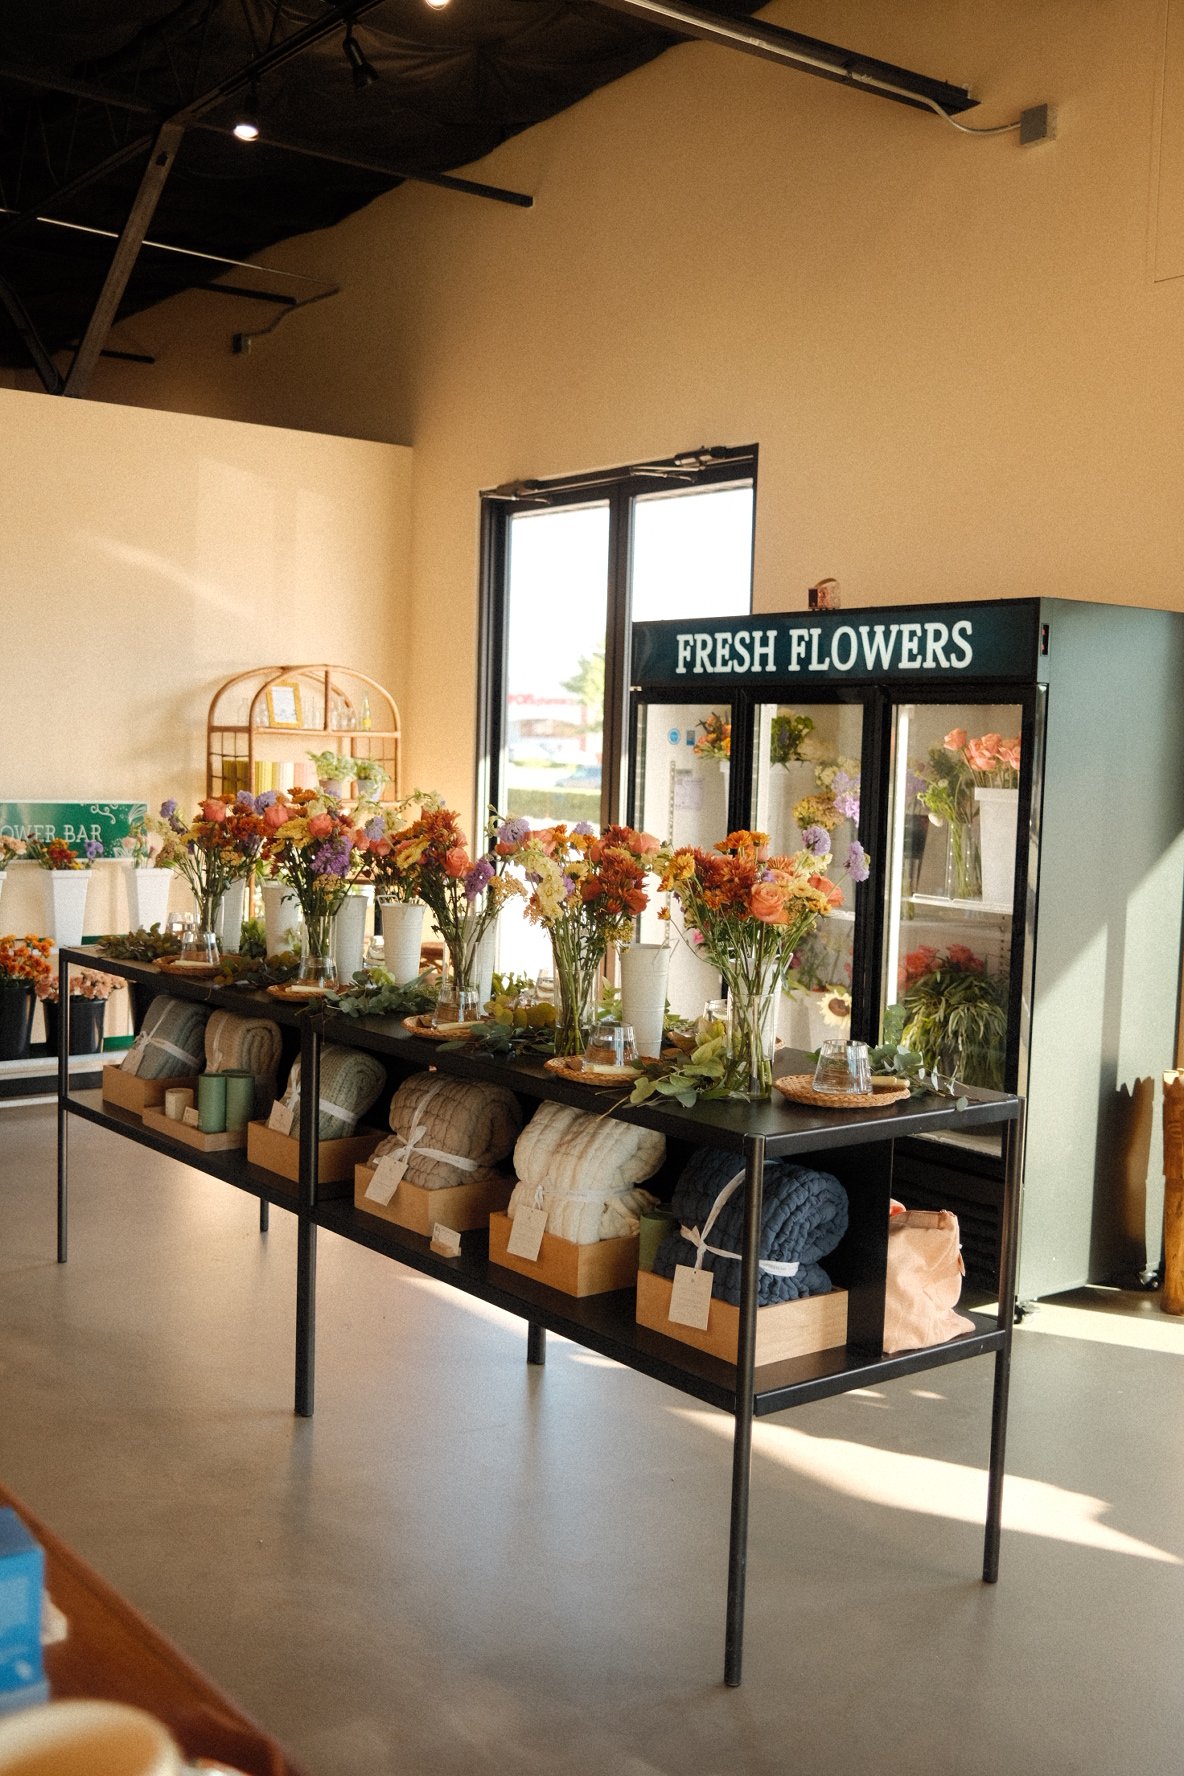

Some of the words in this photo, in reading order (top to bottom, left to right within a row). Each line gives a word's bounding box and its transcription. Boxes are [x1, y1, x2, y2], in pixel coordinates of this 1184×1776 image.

[675, 630, 778, 674] FRESH
[788, 620, 973, 671] FLOWERS
[64, 824, 102, 842] BAR
